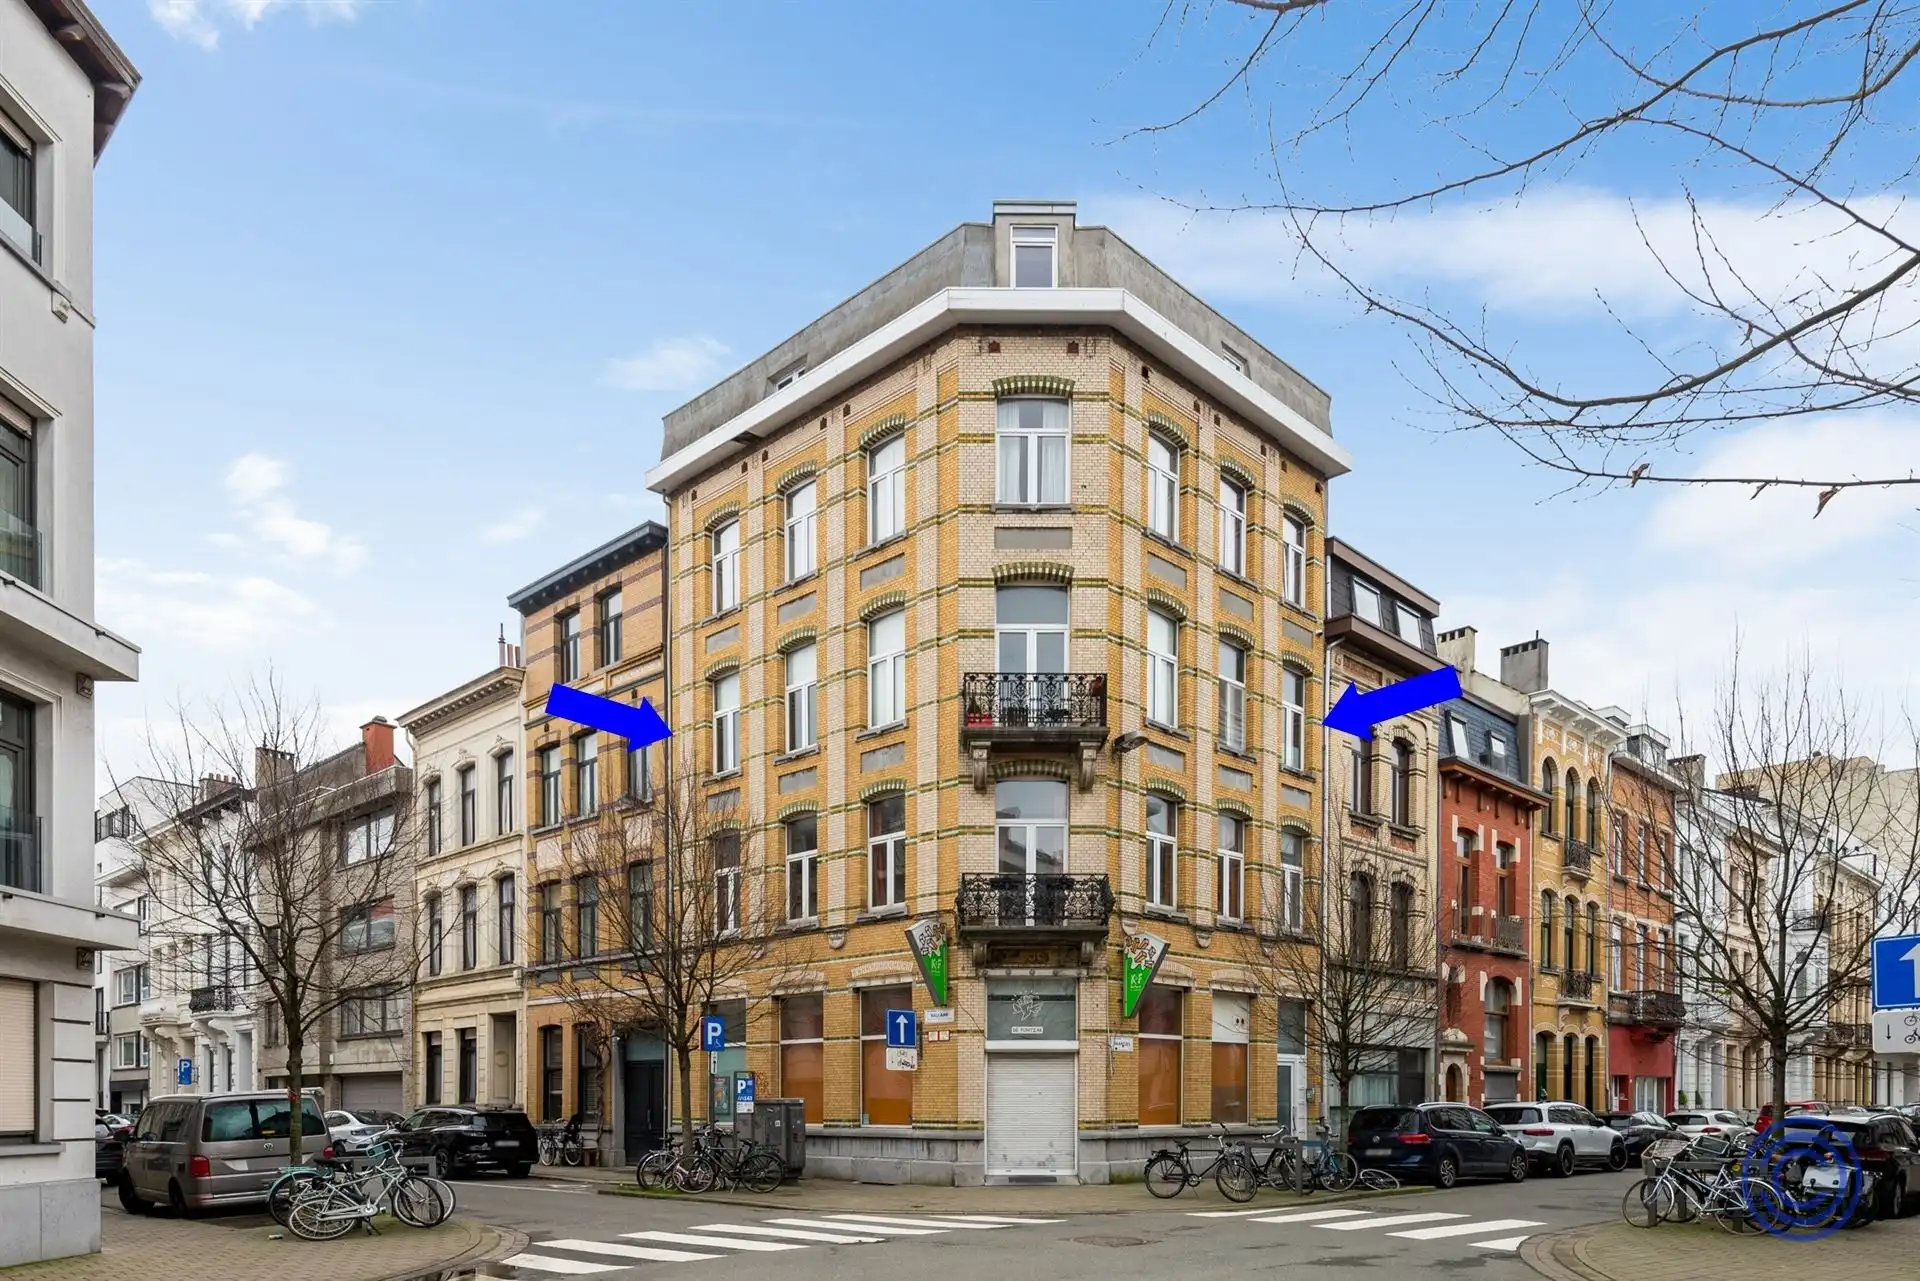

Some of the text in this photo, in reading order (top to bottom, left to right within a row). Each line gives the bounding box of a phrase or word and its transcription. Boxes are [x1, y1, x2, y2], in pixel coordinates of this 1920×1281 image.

[707, 1022, 722, 1045] P
[181, 1061, 190, 1072] P
[737, 1080, 747, 1094] P
